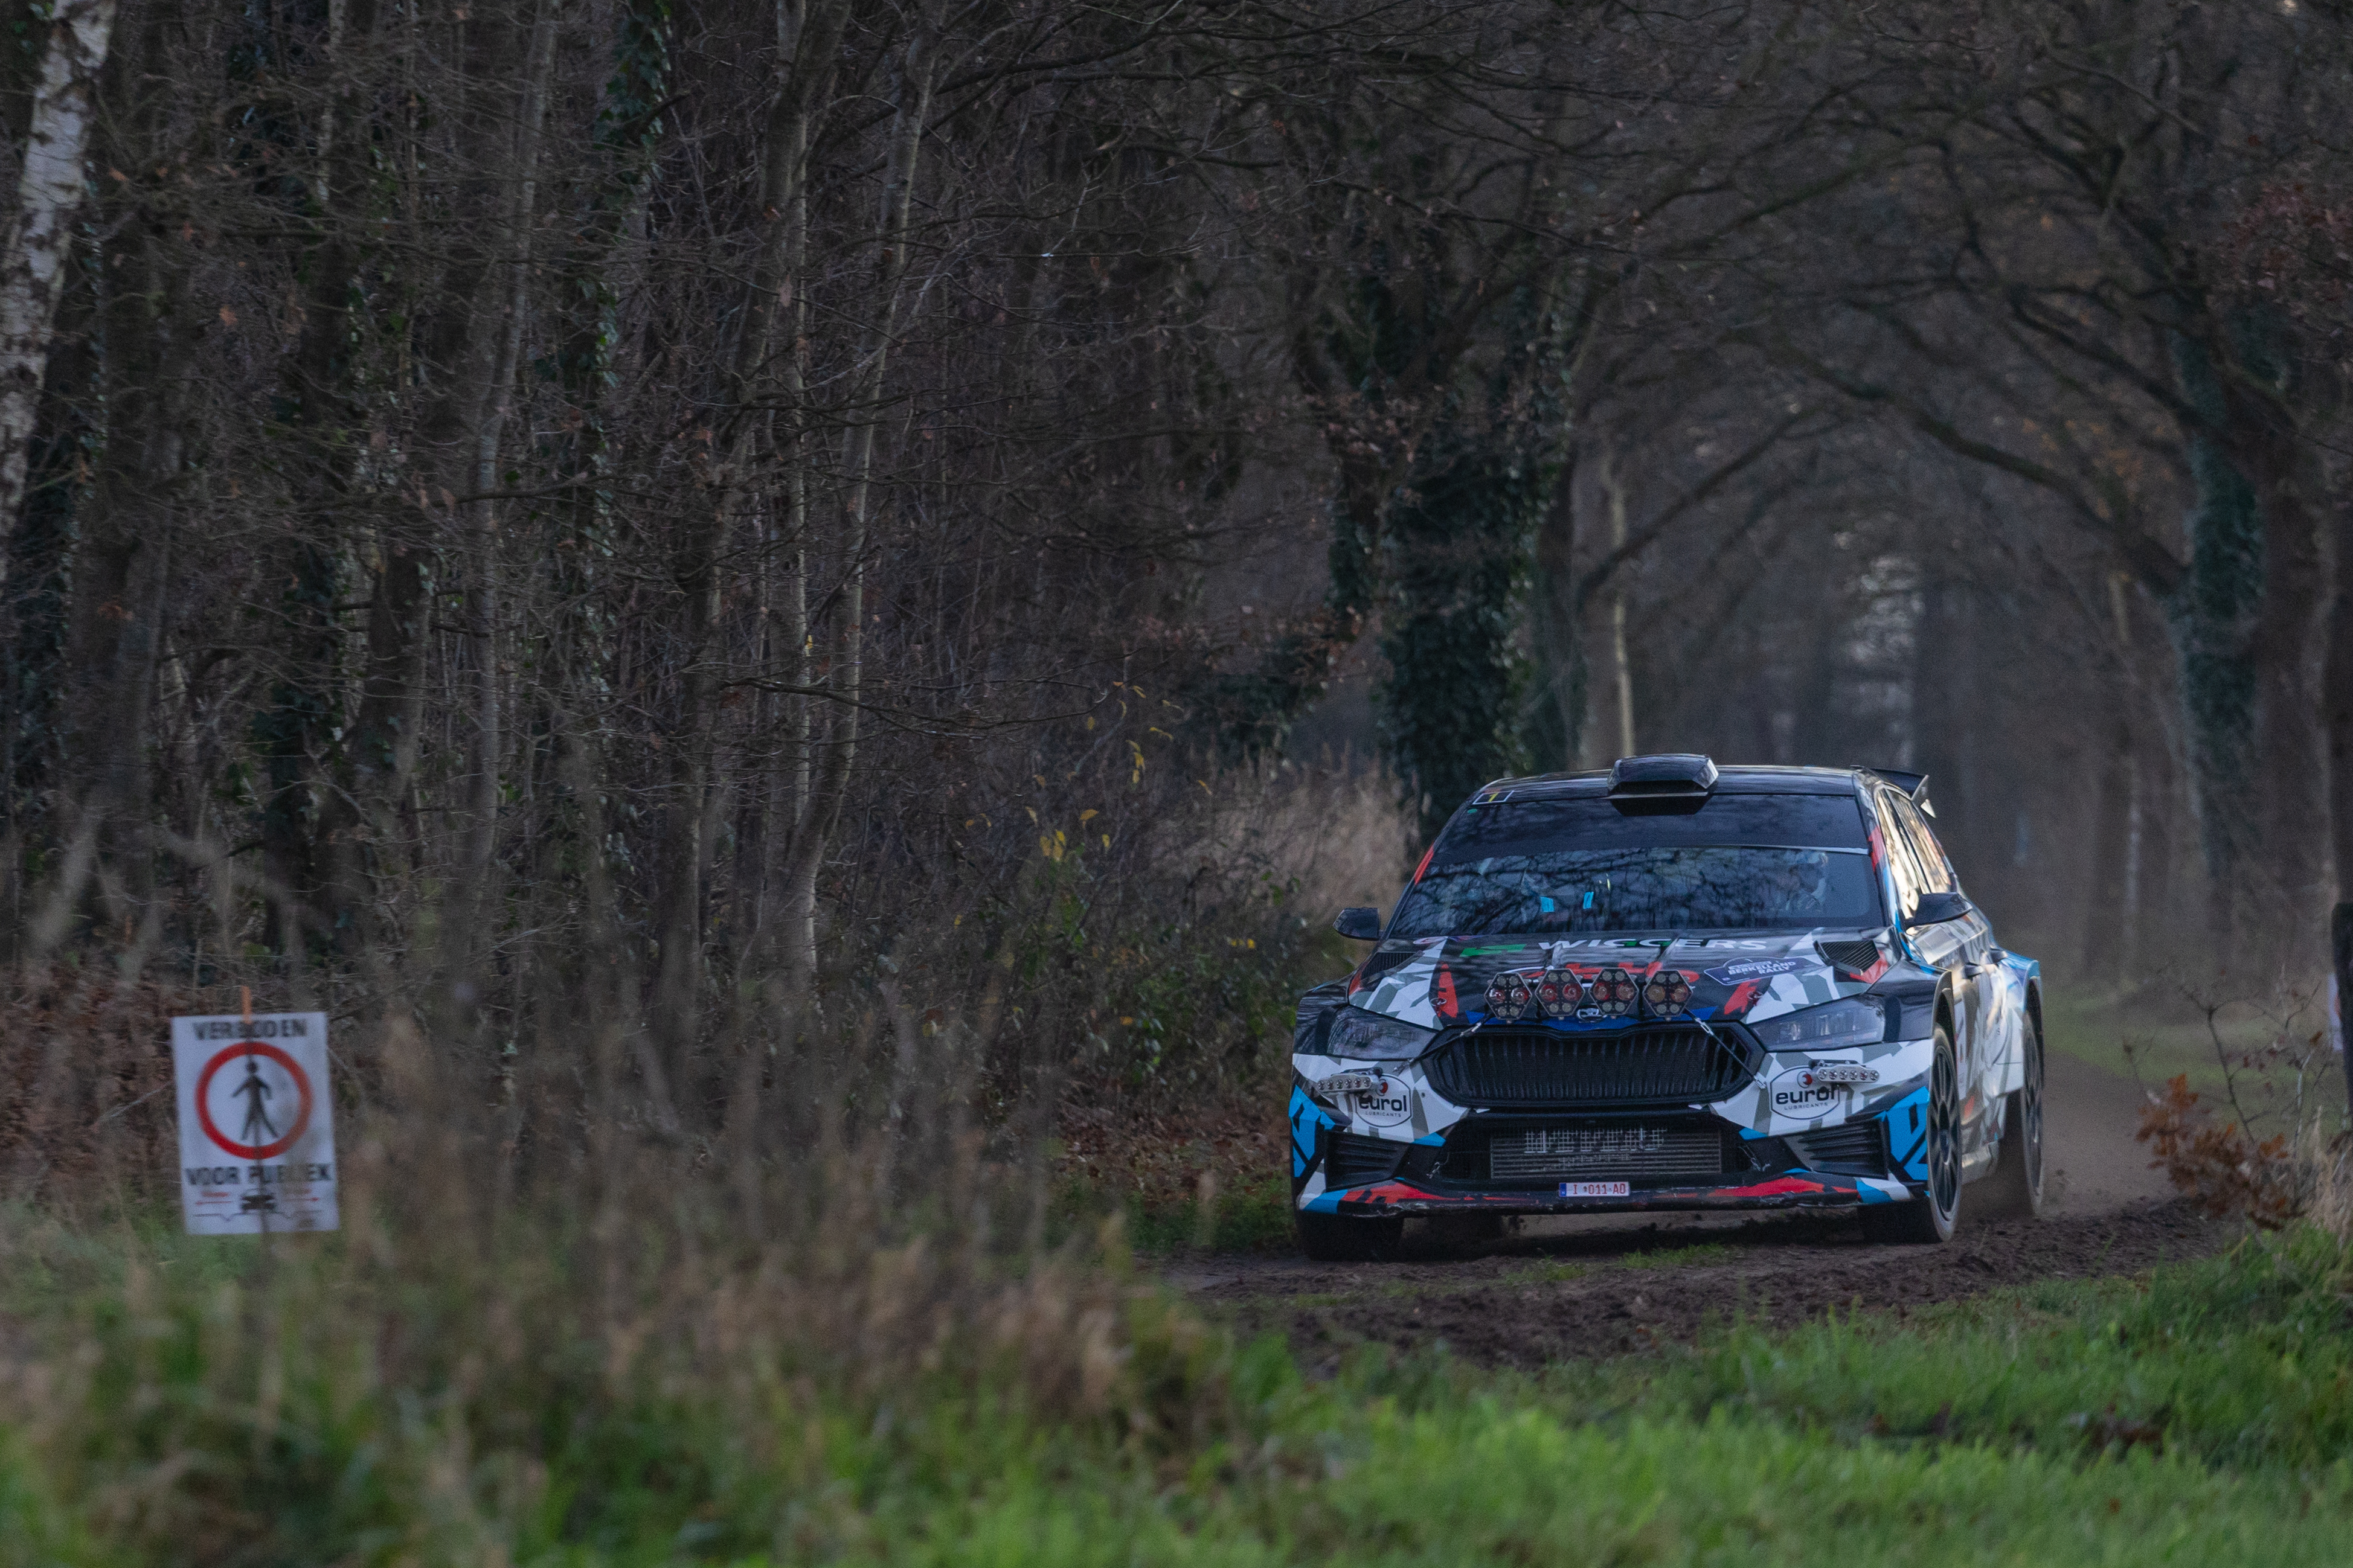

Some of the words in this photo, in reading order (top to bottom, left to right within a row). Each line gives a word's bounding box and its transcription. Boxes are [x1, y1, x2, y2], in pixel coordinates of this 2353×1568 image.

[1538, 938, 1767, 950] WIGGERS
[1728, 962, 1796, 974] BERKELLAND
[1758, 965, 1790, 974] RALLY
[1776, 1086, 1834, 1104] eurol
[1784, 1102, 1828, 1110] LUBRICANTS
